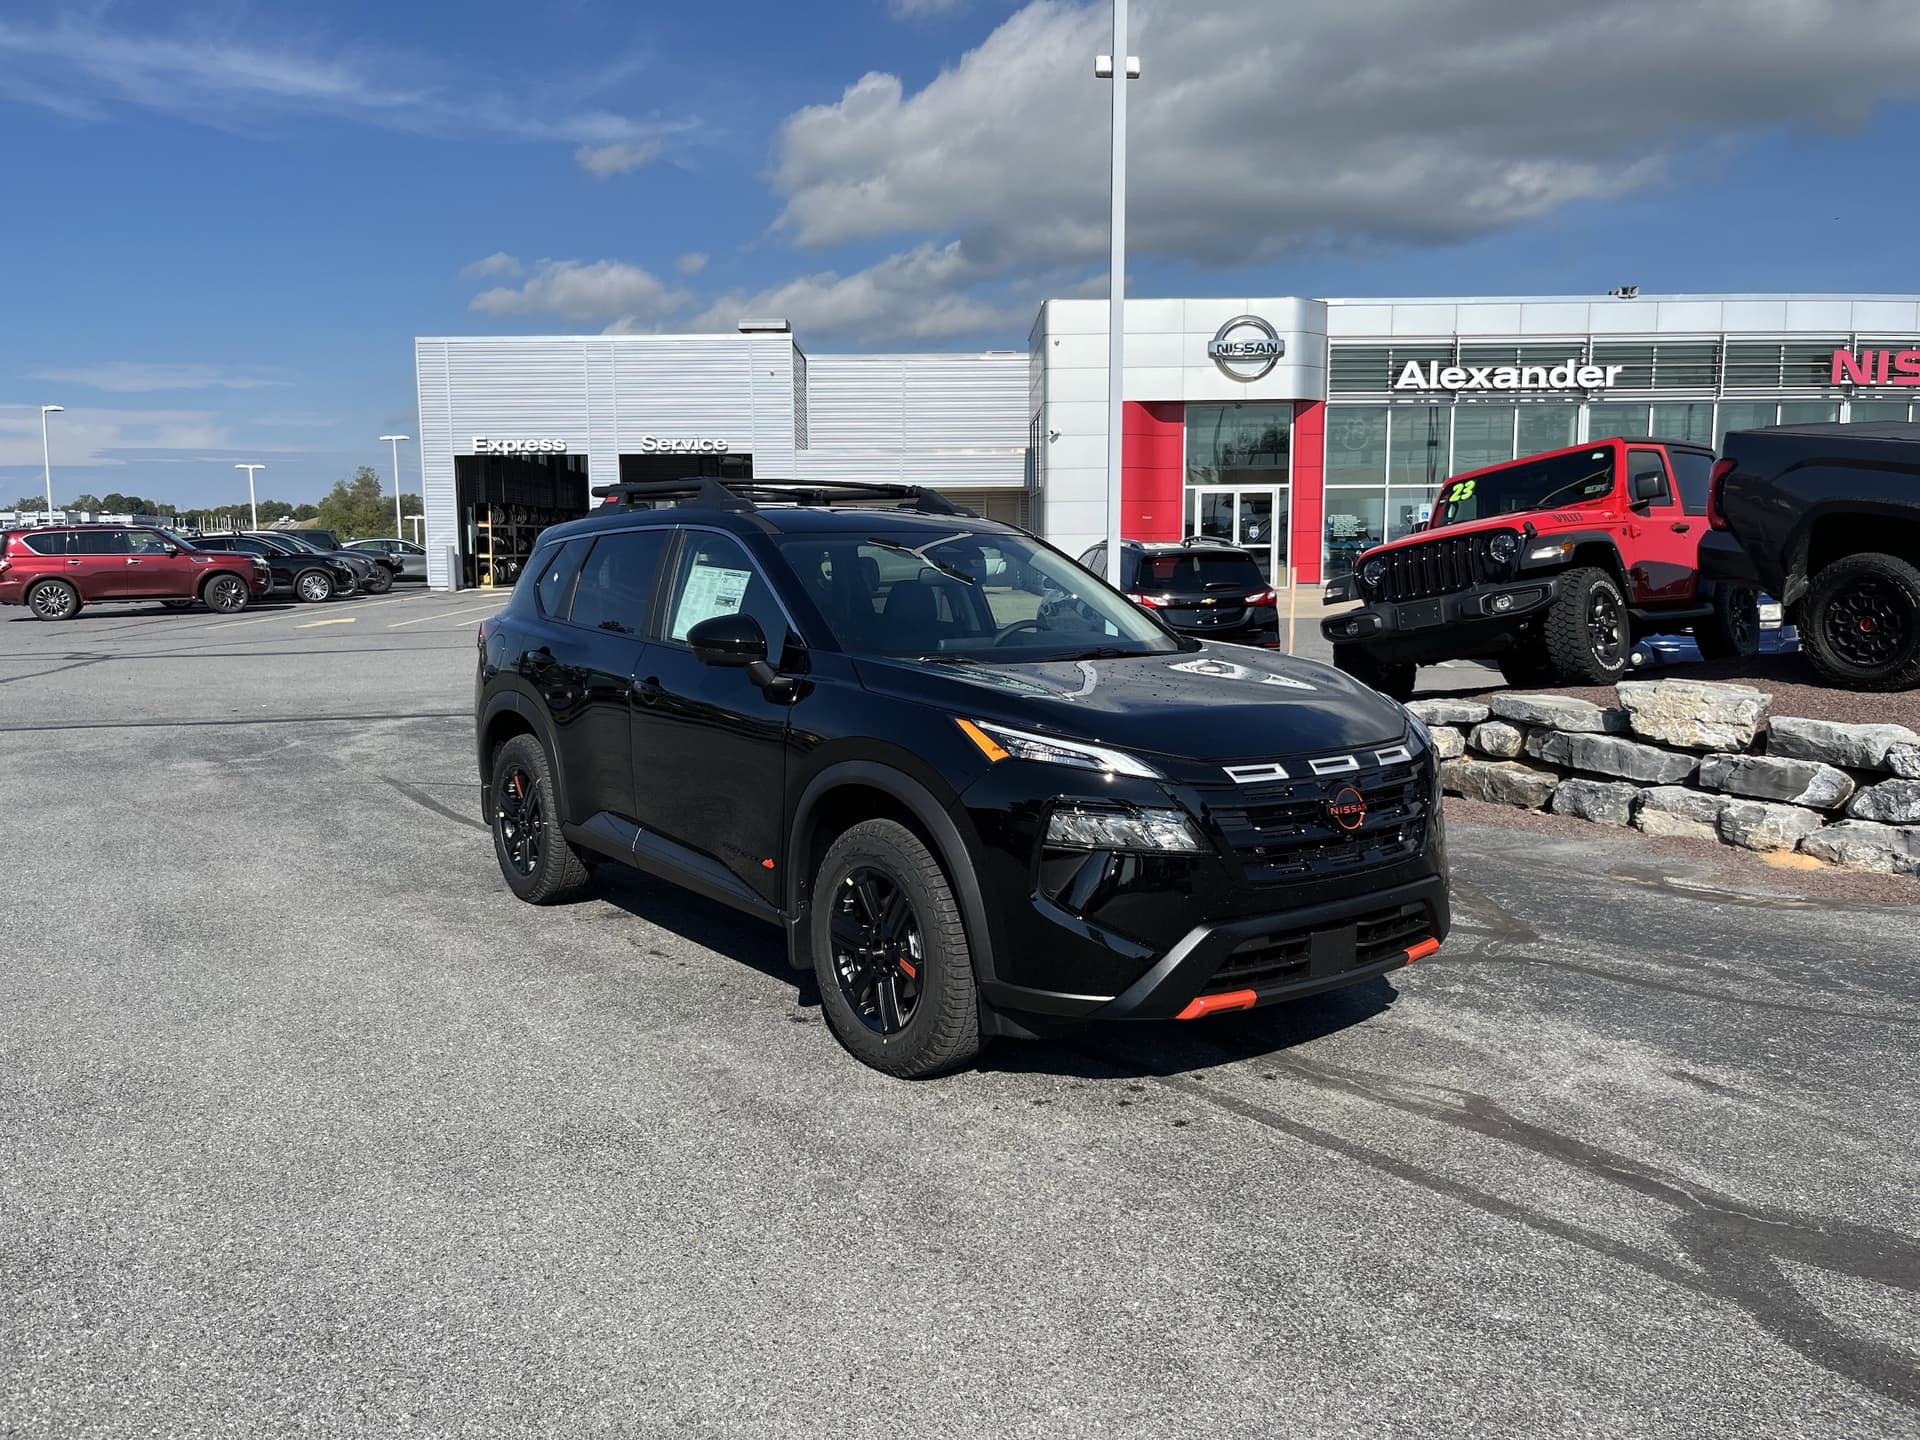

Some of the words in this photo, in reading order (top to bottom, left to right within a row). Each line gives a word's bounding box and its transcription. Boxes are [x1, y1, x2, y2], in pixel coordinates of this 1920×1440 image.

[1216, 342, 1278, 355] NISSAN
[1394, 359, 1623, 389] Alexander
[472, 436, 567, 456] Express
[641, 434, 728, 453] Service
[1449, 480, 1475, 502] 23
[1330, 803, 1367, 815] NISSAN
